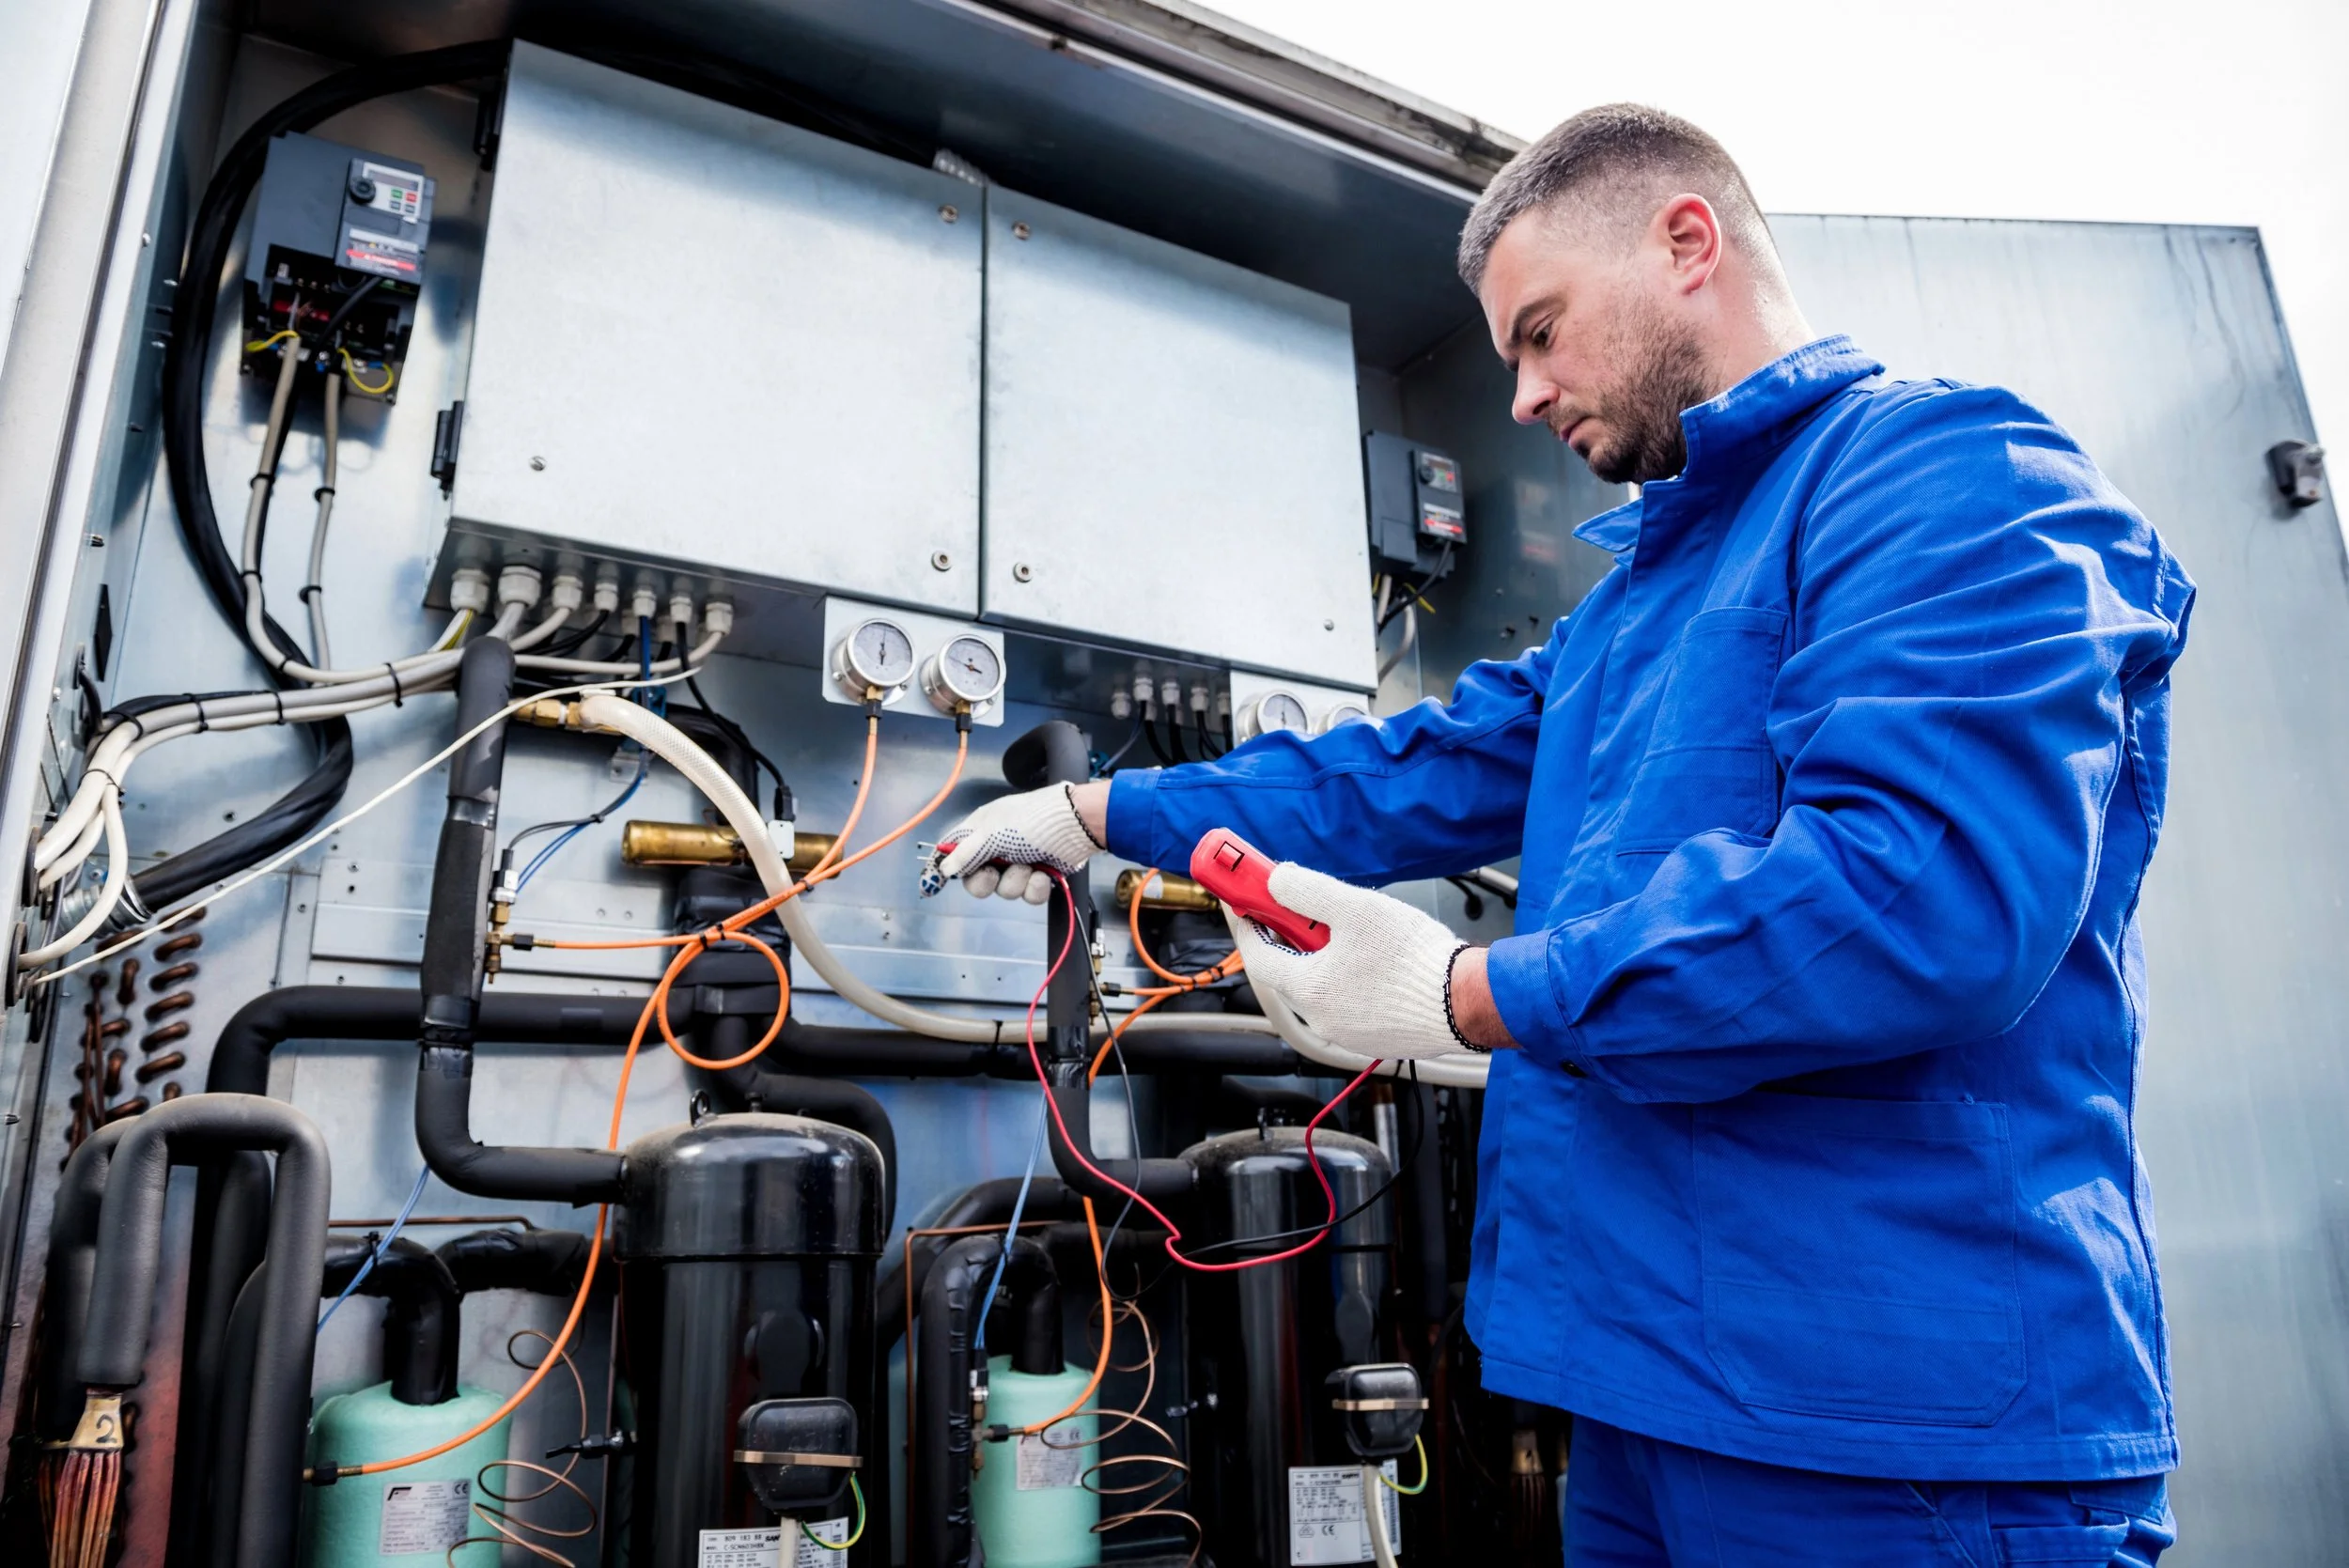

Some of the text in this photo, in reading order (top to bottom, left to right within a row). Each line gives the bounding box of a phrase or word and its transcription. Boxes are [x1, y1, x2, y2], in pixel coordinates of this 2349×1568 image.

[96, 1414, 117, 1443] 2
[454, 1483, 469, 1495] CE
[1321, 1525, 1335, 1536] CE
[765, 1533, 782, 1543] SAN
